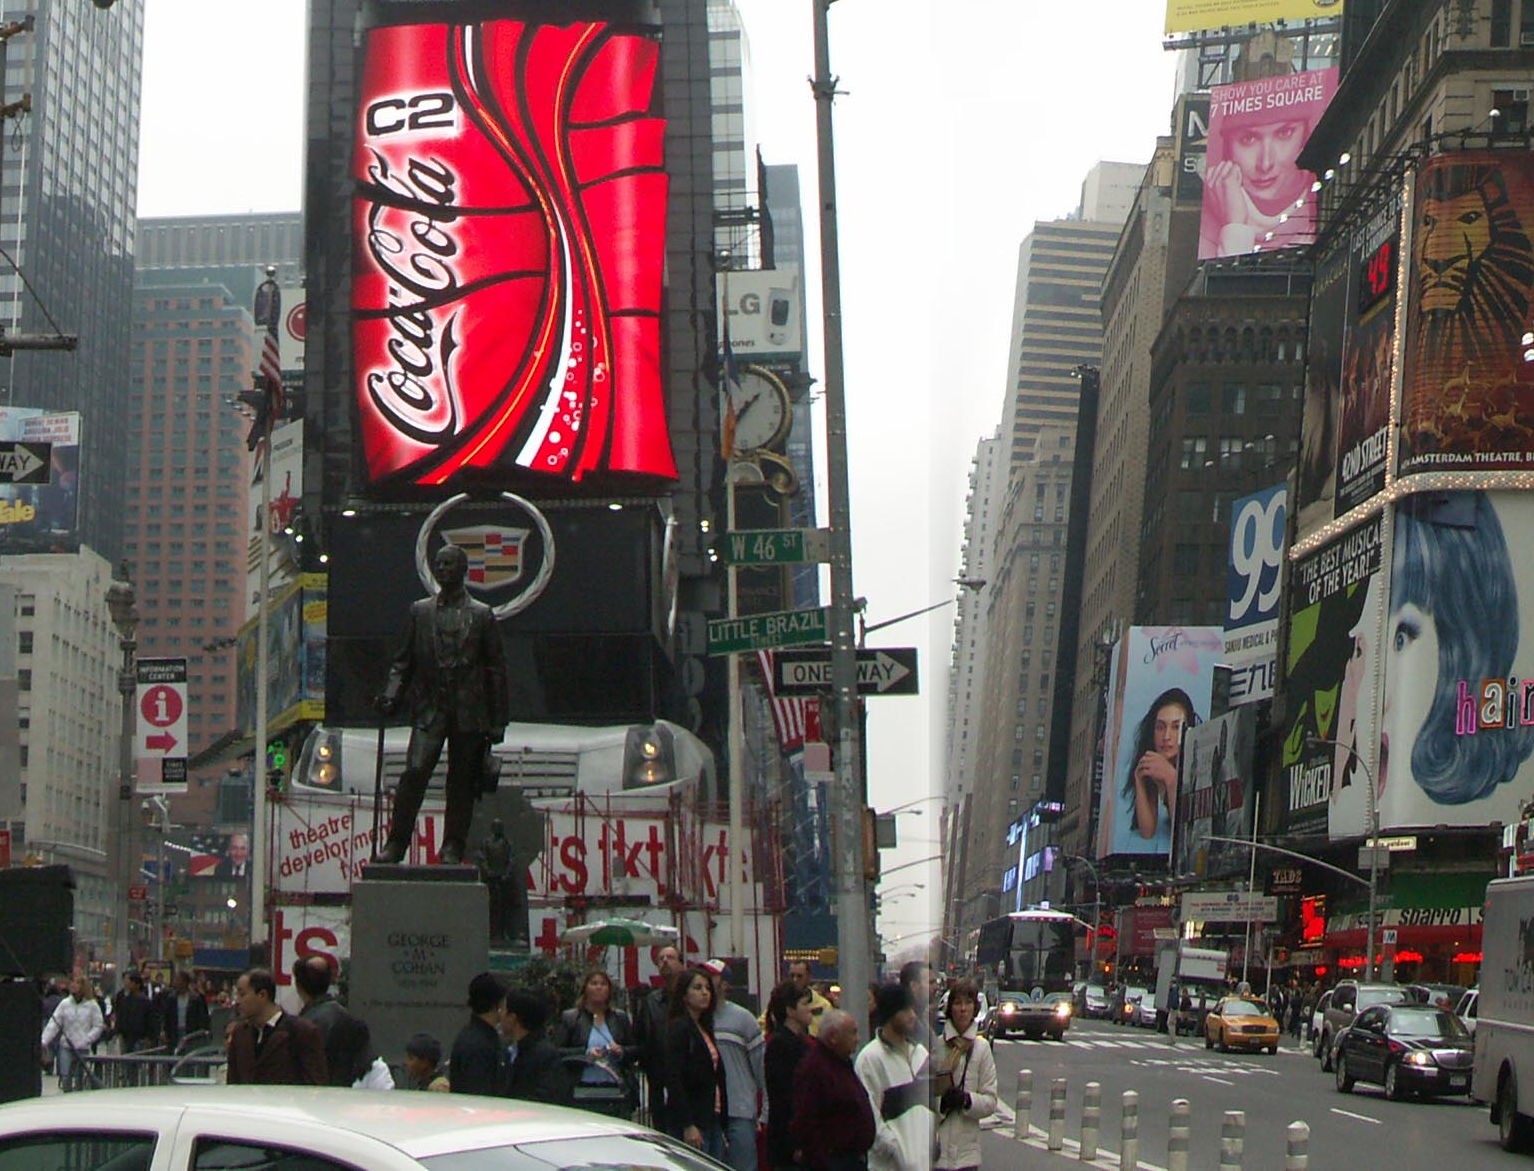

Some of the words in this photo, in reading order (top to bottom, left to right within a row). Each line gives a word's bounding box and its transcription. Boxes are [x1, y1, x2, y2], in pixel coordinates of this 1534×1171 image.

[1210, 104, 1218, 119] 7
[1221, 96, 1263, 117] TIMES
[1266, 85, 1323, 109] SQUARE
[1212, 84, 1247, 103] SHOW
[1250, 79, 1272, 95] YOU
[1275, 75, 1306, 91] CARE
[1309, 71, 1324, 86] AT
[365, 90, 456, 137] C2
[730, 537, 748, 562] W
[752, 535, 776, 561] 46
[782, 533, 799, 549] ST
[709, 619, 759, 643] LITTLE
[765, 609, 825, 635] BRAZIL
[793, 664, 833, 683] ONE
[856, 662, 896, 683] WAY
[387, 932, 450, 949] GEORGE
